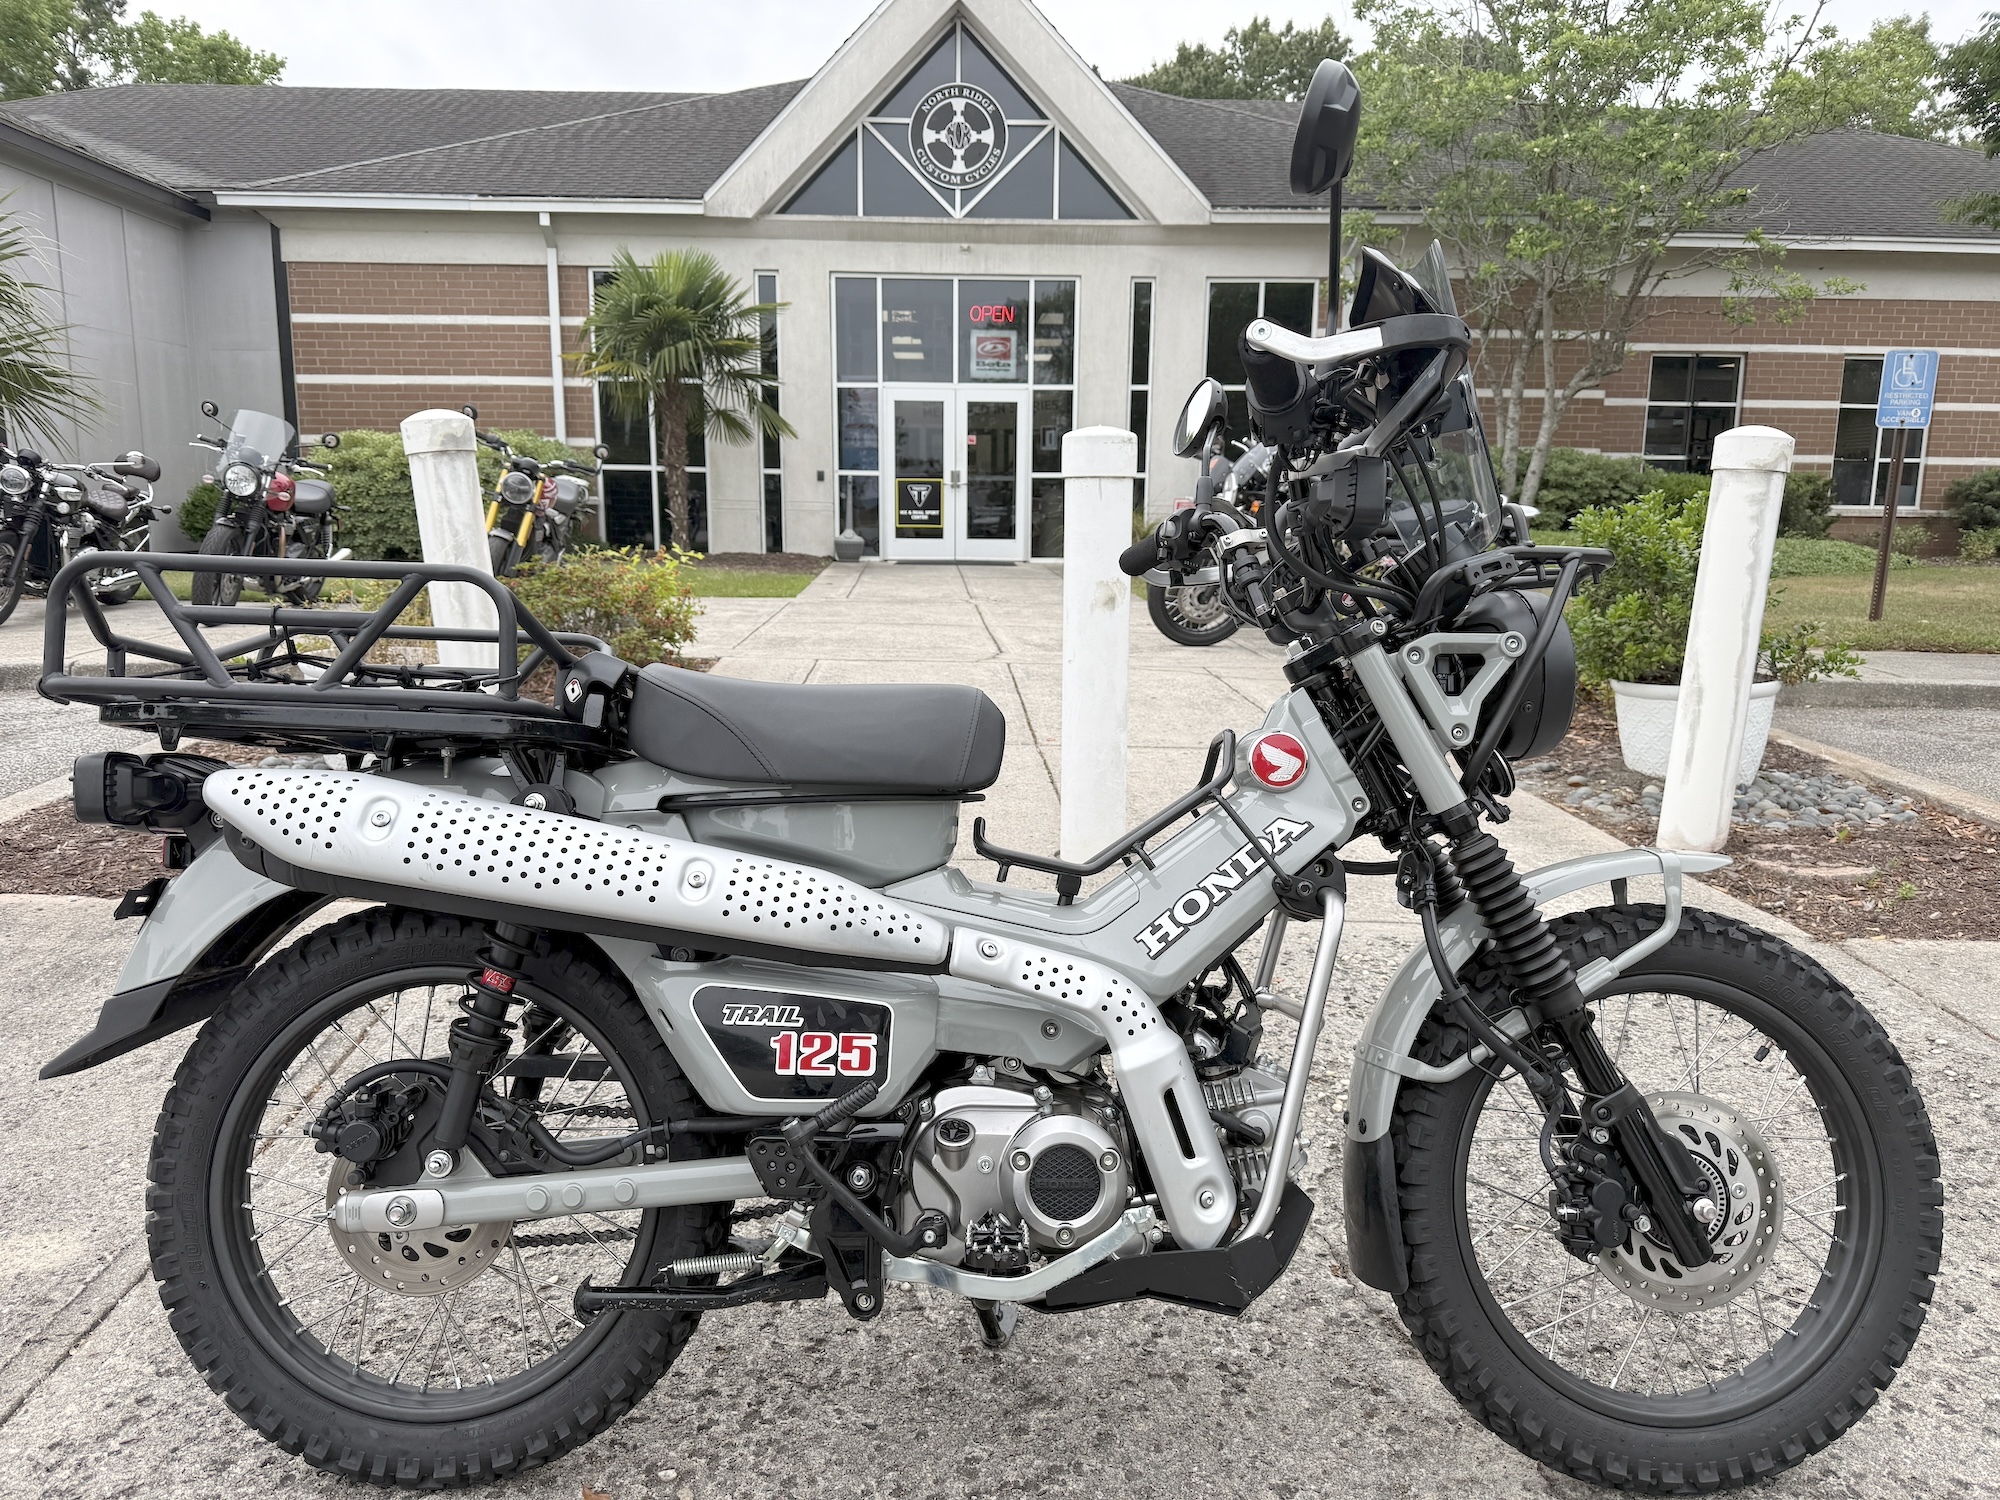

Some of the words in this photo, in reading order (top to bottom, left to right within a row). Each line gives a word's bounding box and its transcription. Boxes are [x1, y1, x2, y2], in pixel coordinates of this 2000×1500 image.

[921, 87, 959, 113] NORTH
[962, 88, 995, 114] RIDGE
[916, 148, 960, 184] CUSTOM
[965, 147, 1001, 183] CYCLES
[969, 305, 1016, 323] OPEN
[1133, 816, 1315, 960] HONDA
[722, 1003, 805, 1027] TRAIL
[770, 1031, 877, 1076] 125
[1034, 1179, 1097, 1189] HONDA
[183, 1174, 206, 1274] GOLDEN
[1477, 1335, 1515, 1377] BOY
[1521, 1383, 1614, 1443] GOLDEN
